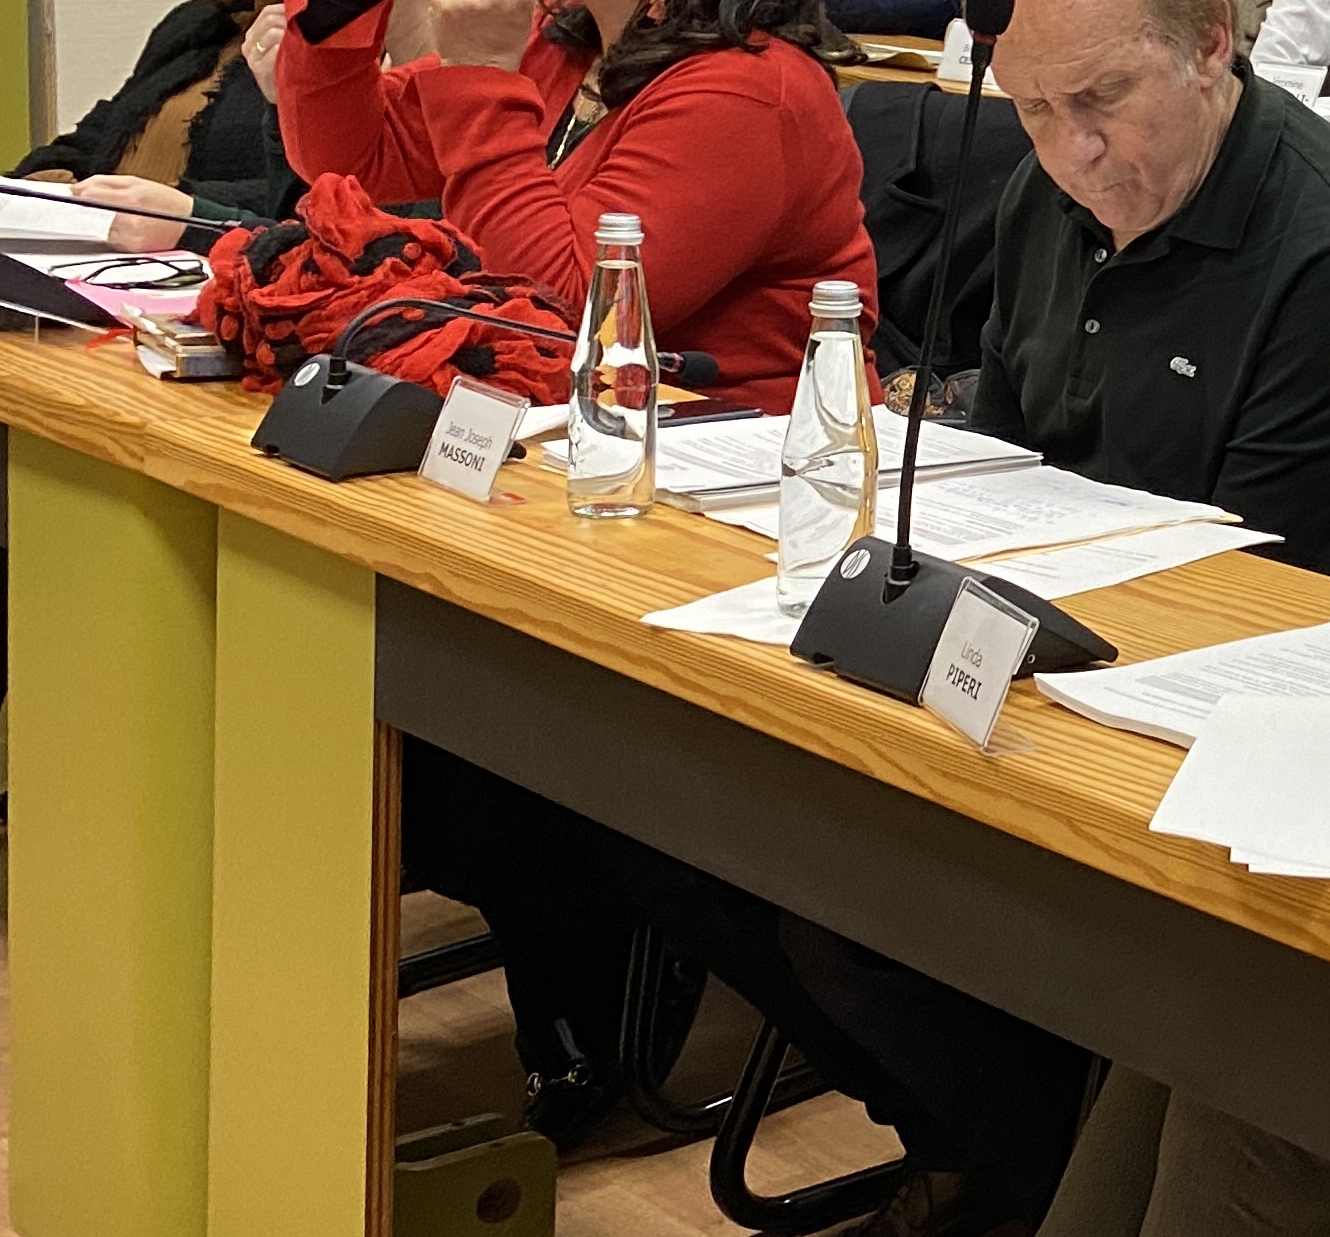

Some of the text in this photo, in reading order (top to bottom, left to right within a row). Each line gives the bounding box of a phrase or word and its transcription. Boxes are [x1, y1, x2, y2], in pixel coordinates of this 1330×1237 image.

[445, 421, 493, 451] Jean Joseph
[438, 442, 486, 472] MASSONI
[961, 640, 983, 669] Linda
[945, 663, 983, 700] PIPERI
